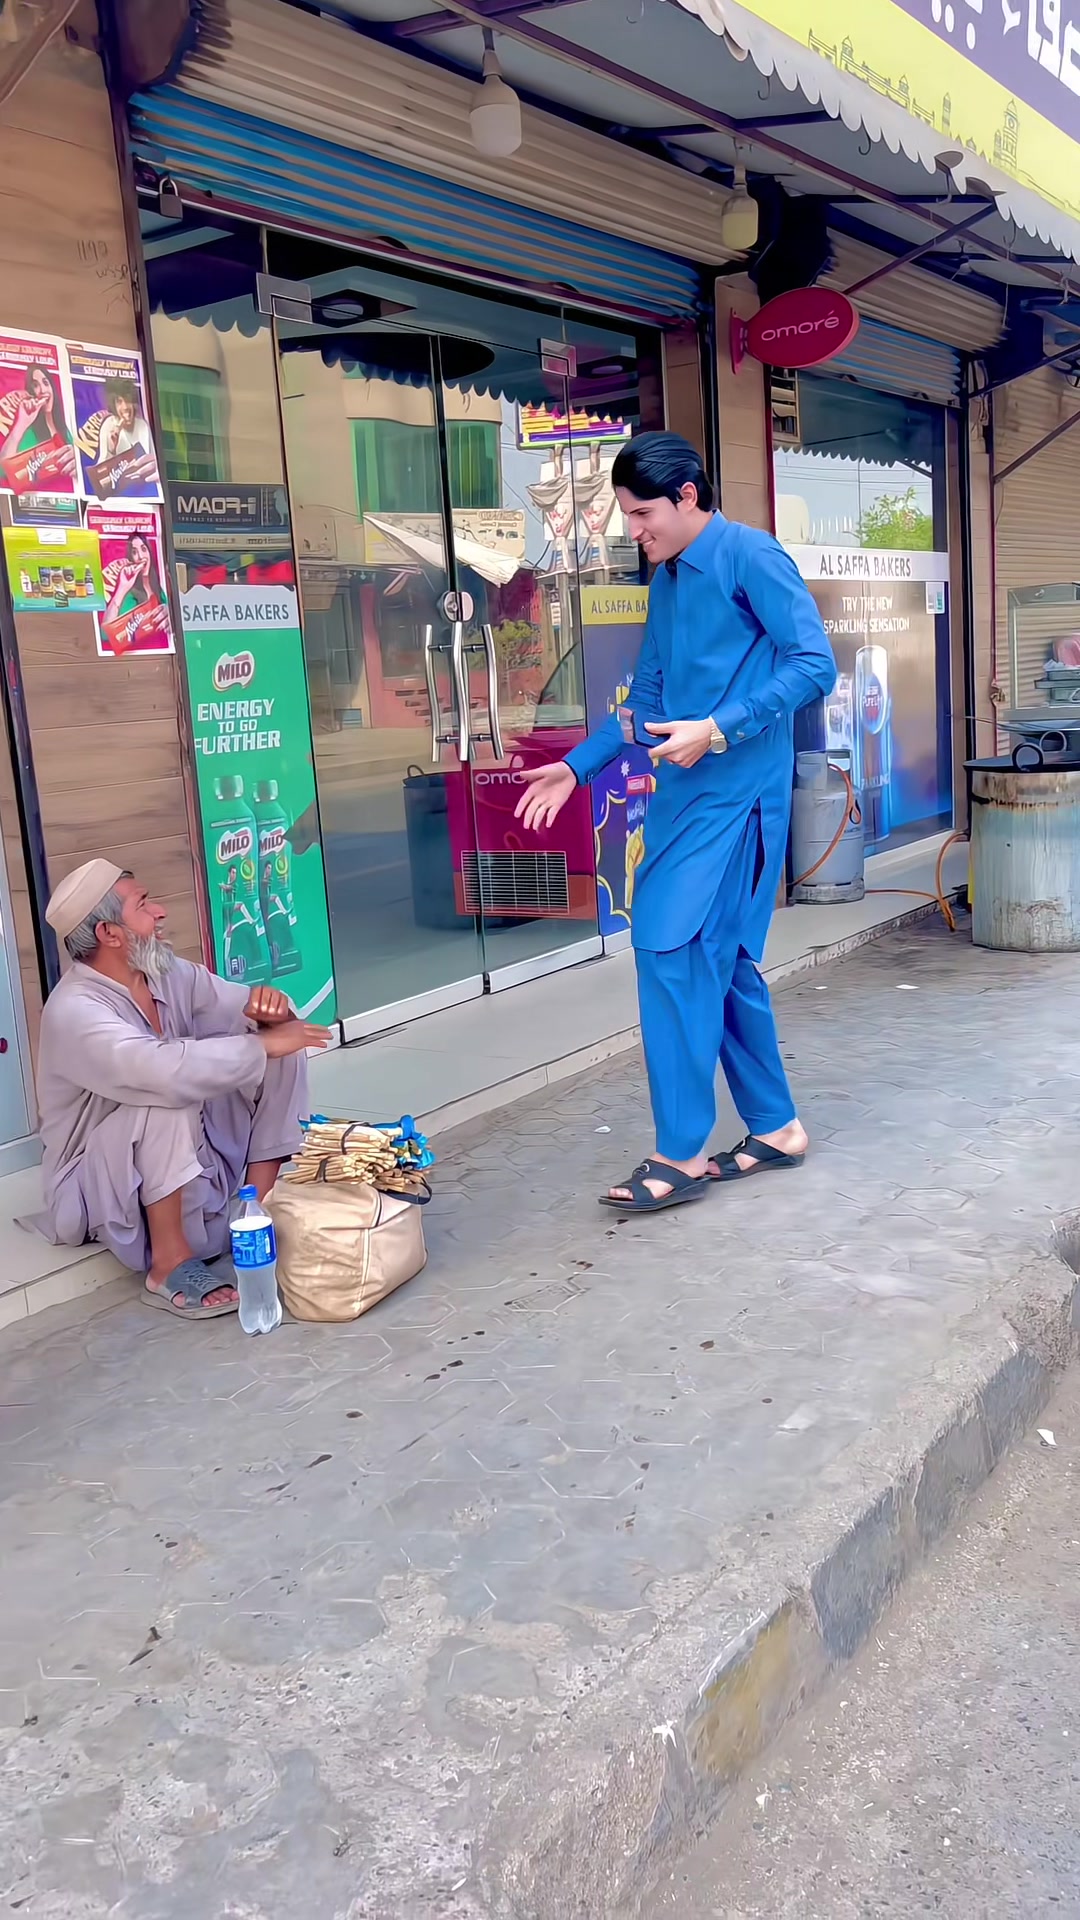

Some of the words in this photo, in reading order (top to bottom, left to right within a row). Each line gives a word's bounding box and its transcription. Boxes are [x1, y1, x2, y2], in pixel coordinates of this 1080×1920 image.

[761, 310, 839, 341] omoré
[820, 554, 834, 577] AL
[837, 555, 871, 577] SAFFA
[874, 556, 912, 577] BAKERS
[182, 605, 231, 622] SAFFA
[234, 604, 289, 621] BAKERS
[592, 600, 602, 614] AL
[605, 600, 633, 613] SAFFA
[842, 597, 858, 613] TRY
[860, 596, 875, 612] THE
[876, 596, 893, 611] NEW
[824, 619, 868, 635] SPARKLING
[869, 617, 910, 633] SENSATION
[217, 661, 252, 682] MILO
[197, 698, 275, 721] ENERGY
[218, 721, 235, 734] TO
[240, 719, 258, 732] GO
[194, 730, 281, 755] FURTHER
[475, 772, 528, 785] omo
[220, 835, 250, 857] MILO
[260, 834, 284, 852] MILO
